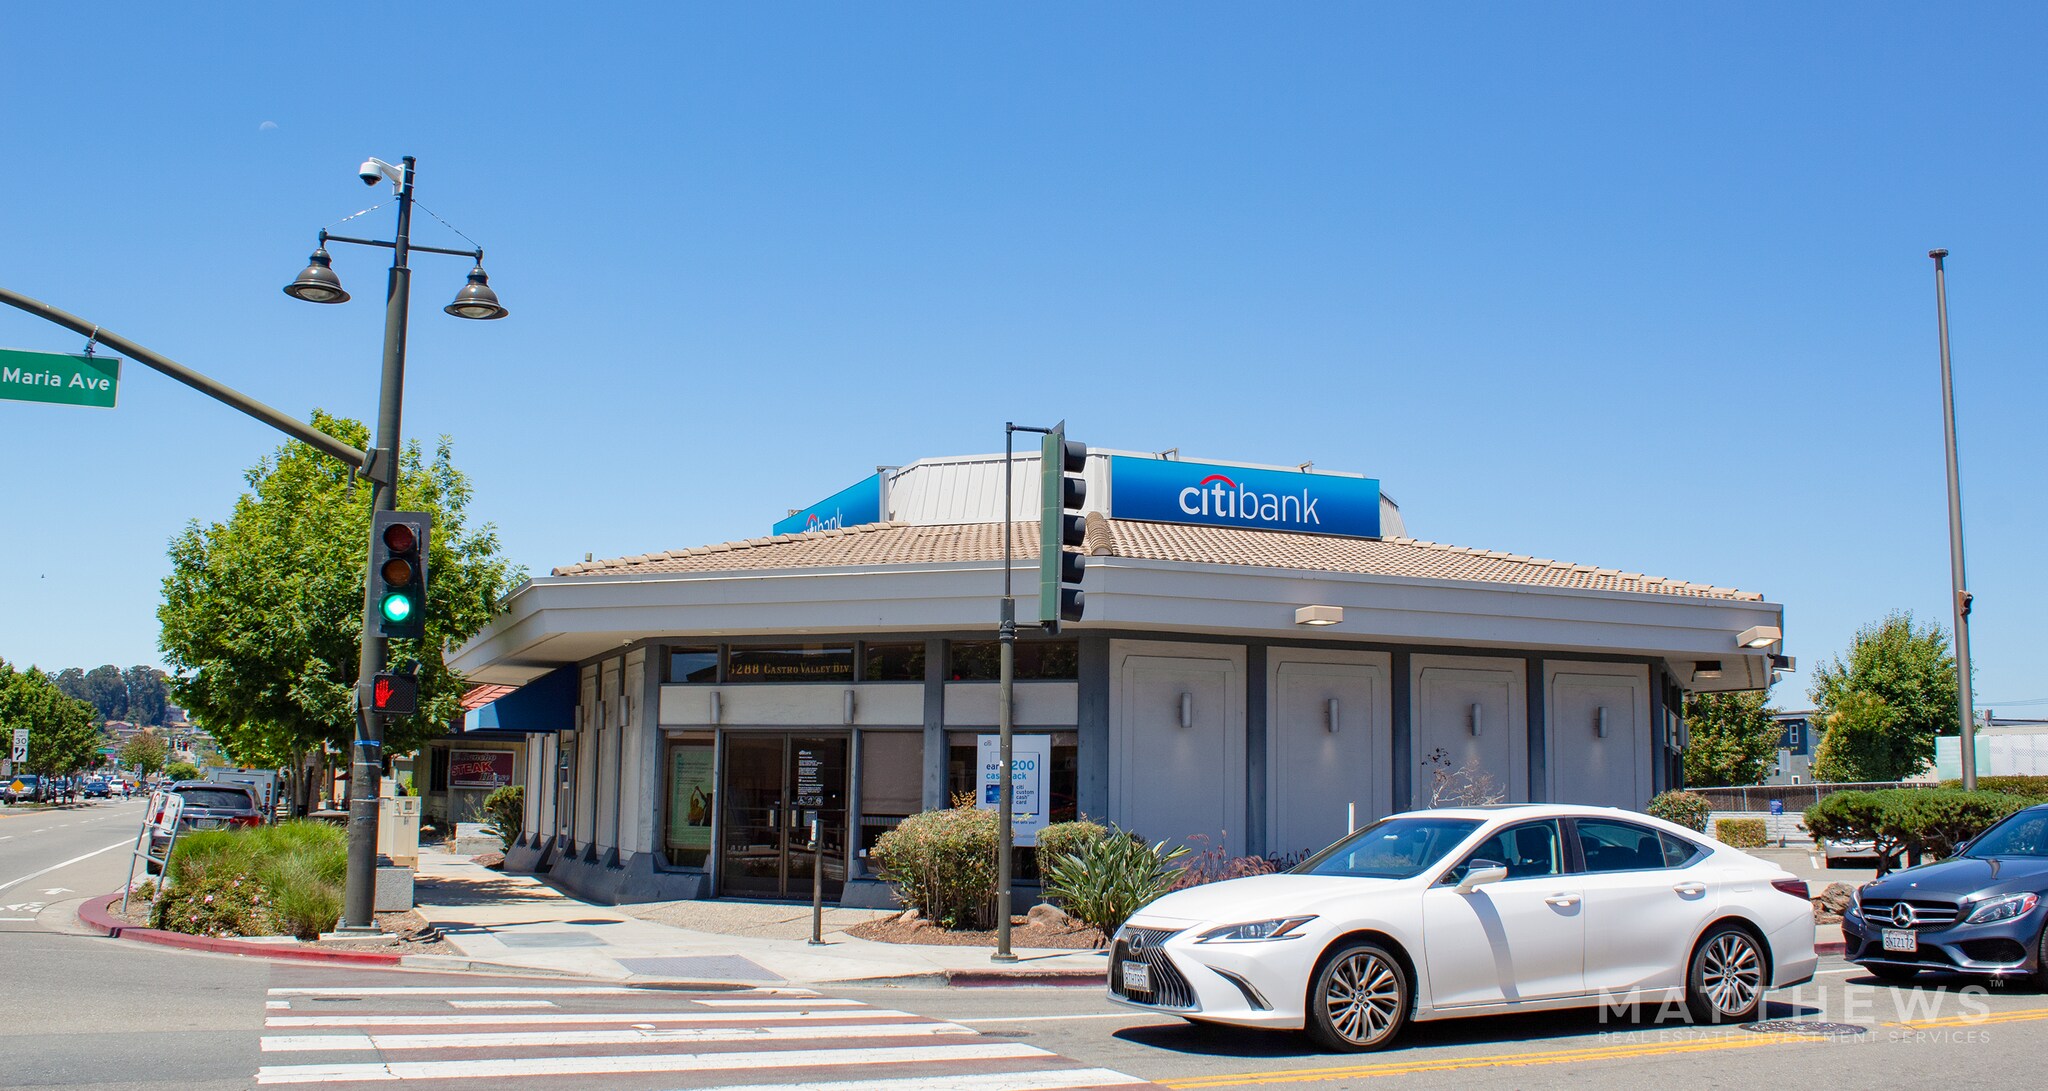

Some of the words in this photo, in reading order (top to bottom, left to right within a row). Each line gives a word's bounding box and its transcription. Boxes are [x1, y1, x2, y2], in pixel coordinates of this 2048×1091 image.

[2, 366, 62, 387] Maria
[68, 372, 111, 391] Ave
[1179, 481, 1320, 524] citibank
[451, 761, 493, 776] STEAK
[1012, 772, 1027, 780] ack
